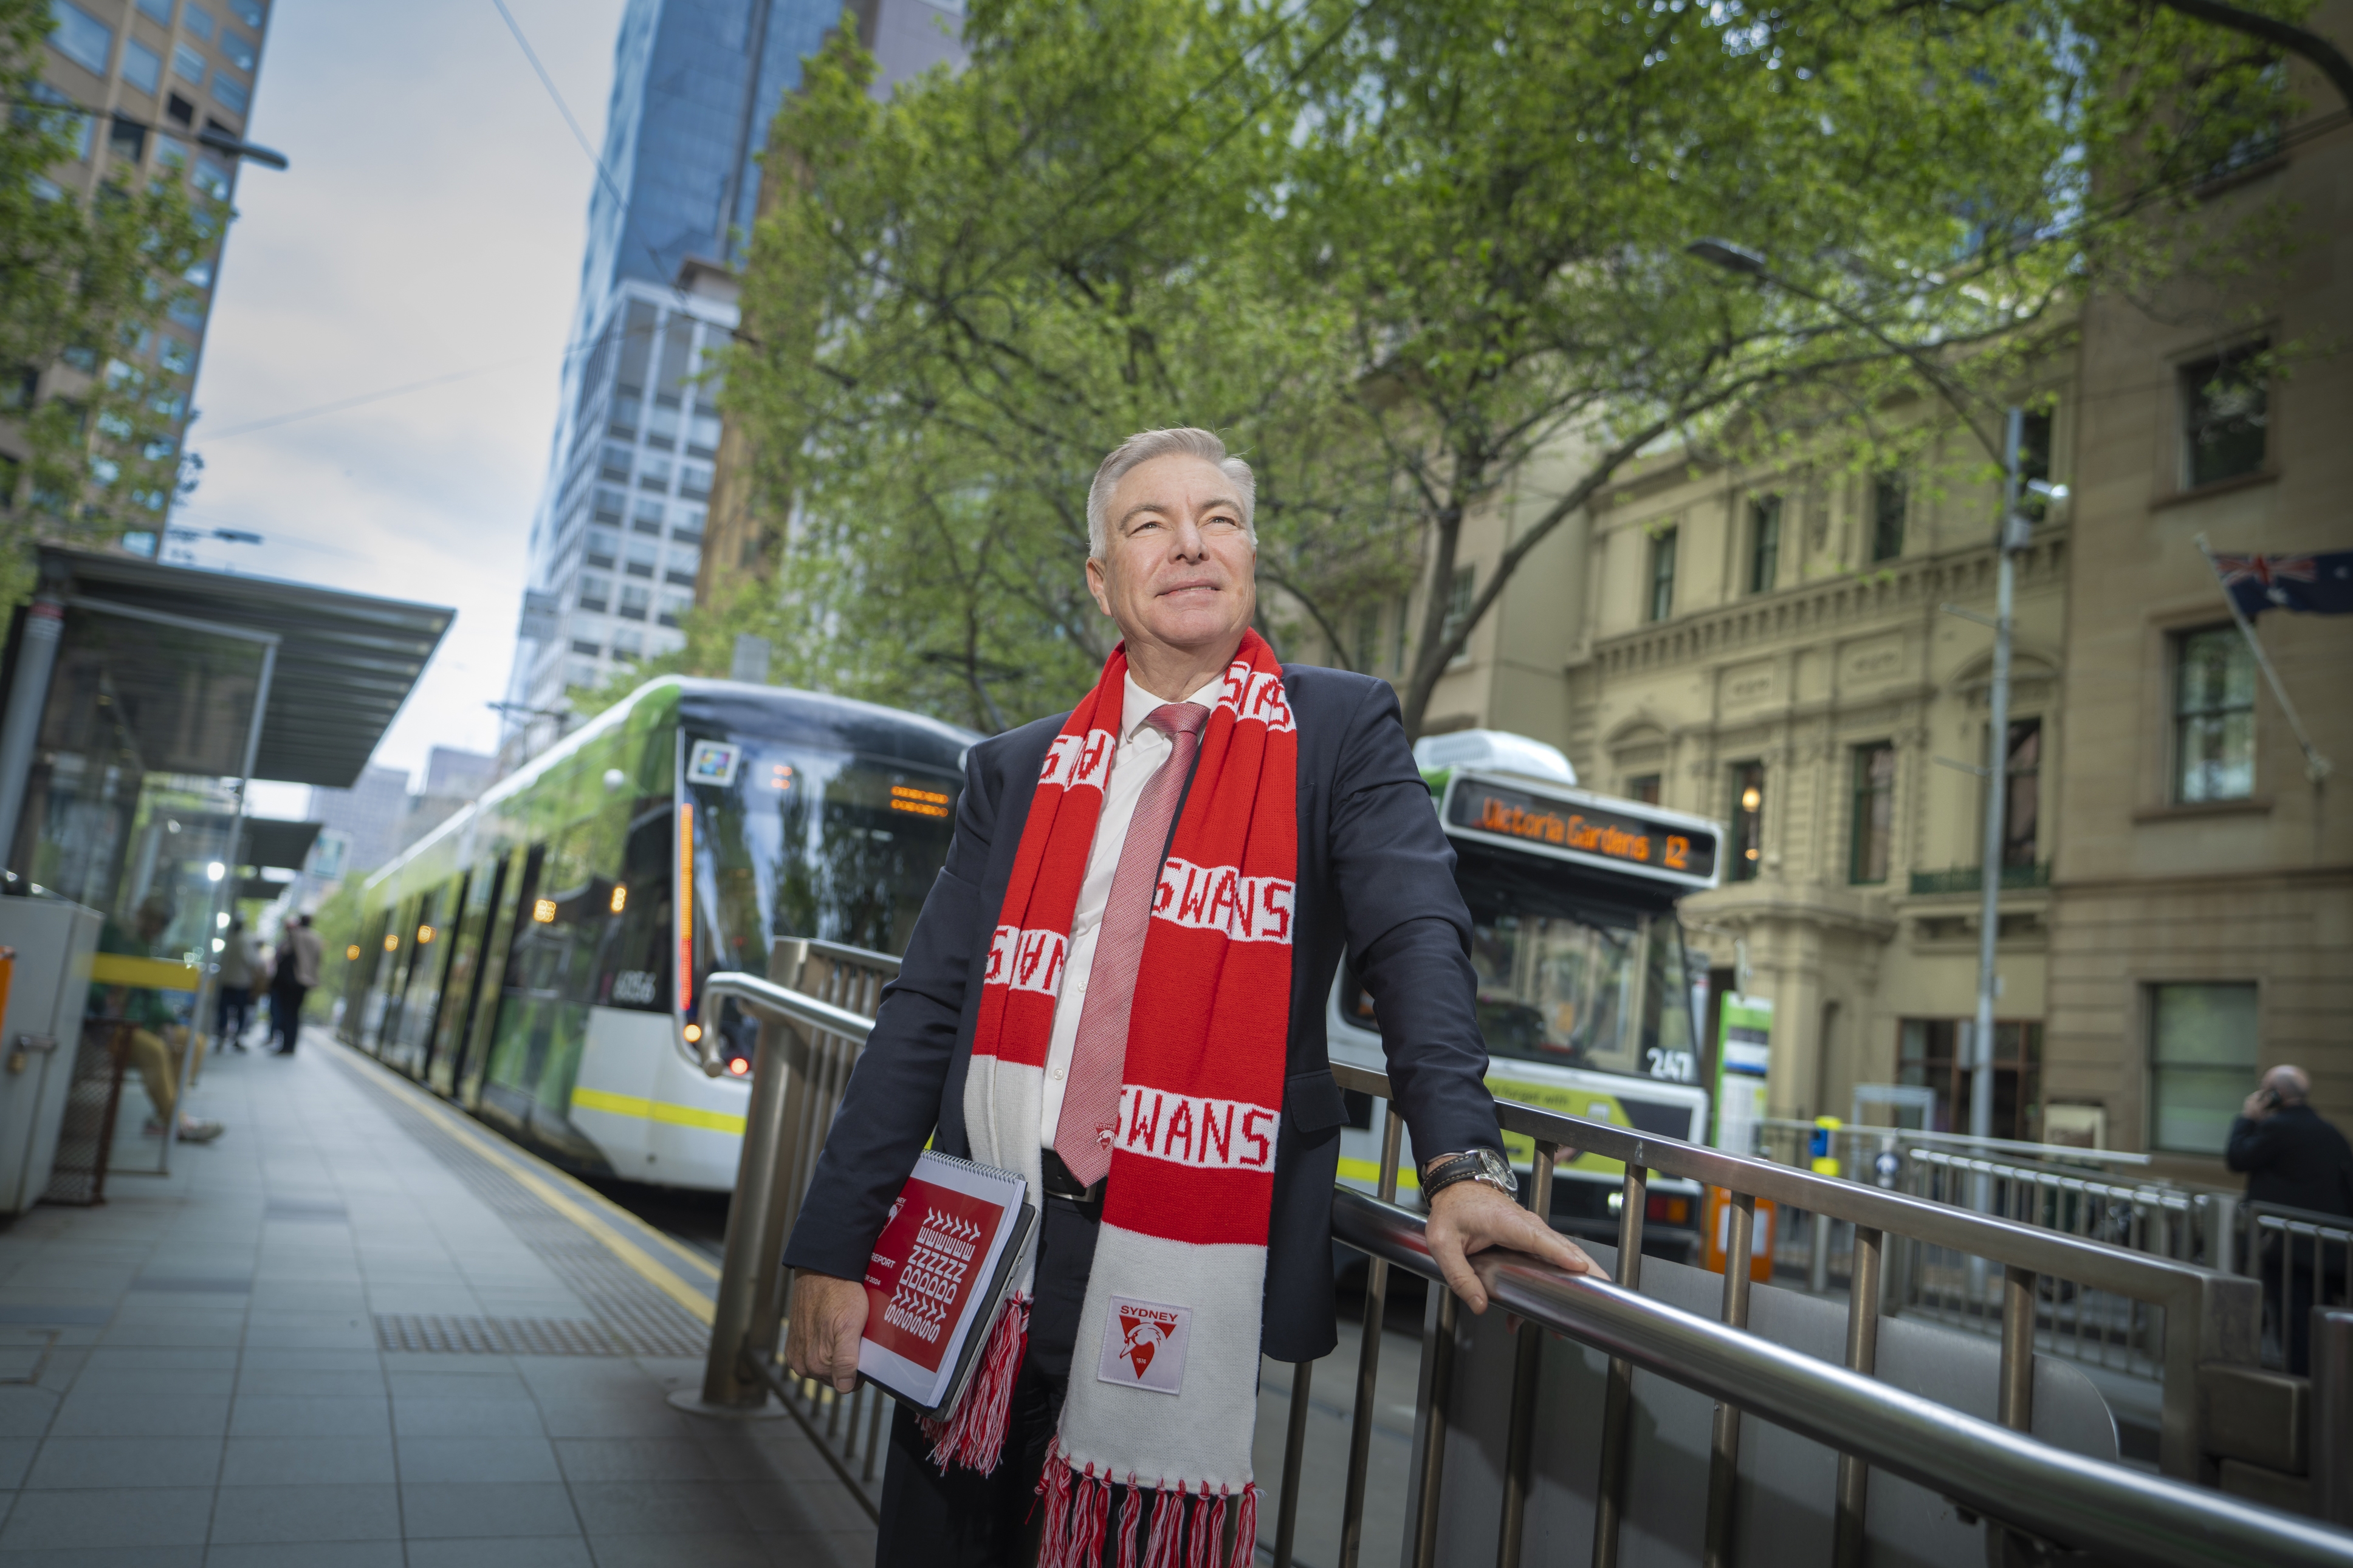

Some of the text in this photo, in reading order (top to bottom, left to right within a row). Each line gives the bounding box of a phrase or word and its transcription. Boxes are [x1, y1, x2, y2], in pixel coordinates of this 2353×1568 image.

[1482, 797, 1690, 870] Victoria Gardens 12
[1153, 861, 1291, 939] SWANS
[1646, 1047, 1692, 1081] 247
[1115, 1089, 1273, 1167] WANS
[871, 1252, 896, 1268] REPORT
[869, 1276, 881, 1286] 2024
[1120, 1305, 1178, 1322] SYDNEY
